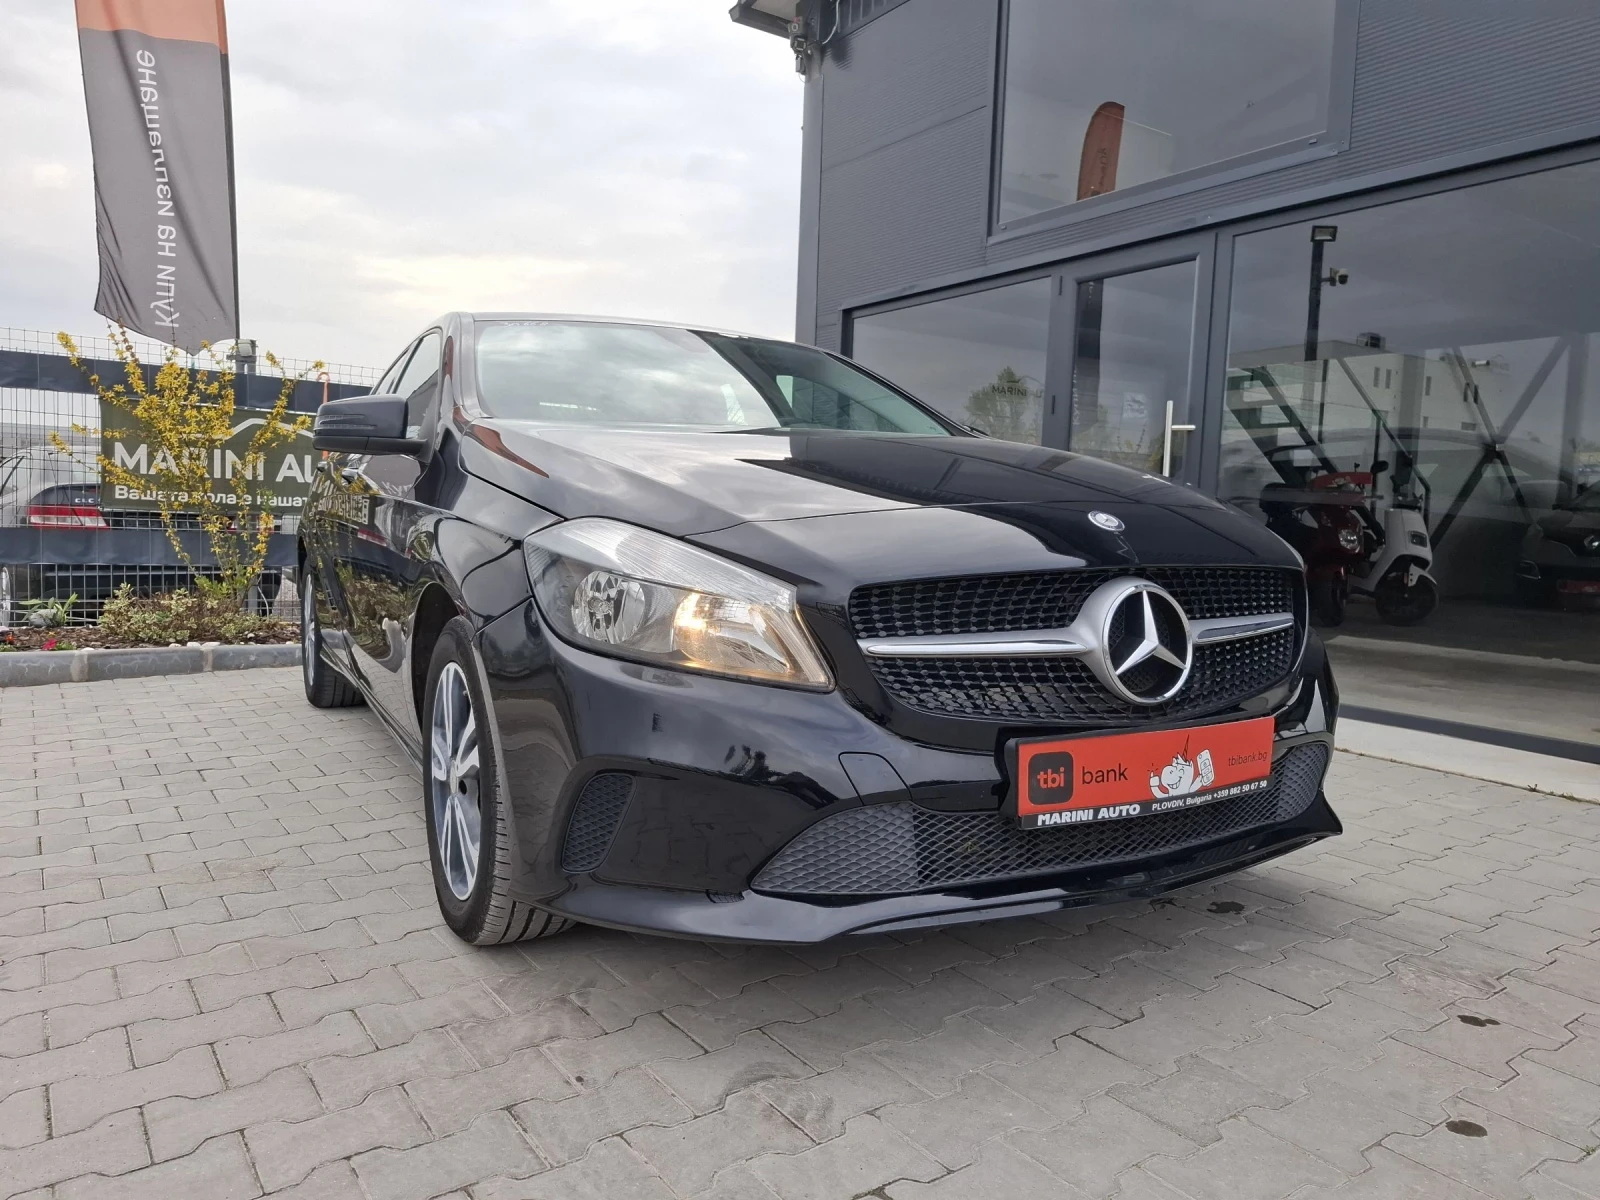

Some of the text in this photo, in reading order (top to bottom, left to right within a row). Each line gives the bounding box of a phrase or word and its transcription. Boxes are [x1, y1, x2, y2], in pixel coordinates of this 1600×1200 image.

[991, 385, 1027, 397] MARINI
[192, 492, 237, 505] ола
[1228, 750, 1268, 767] tbibank.bg
[1037, 762, 1128, 789] tbi bank
[1152, 780, 1268, 811] PLOVDIV, Bulgaria +359 882 50 67 50
[1037, 804, 1141, 826] MARINI AUTO
